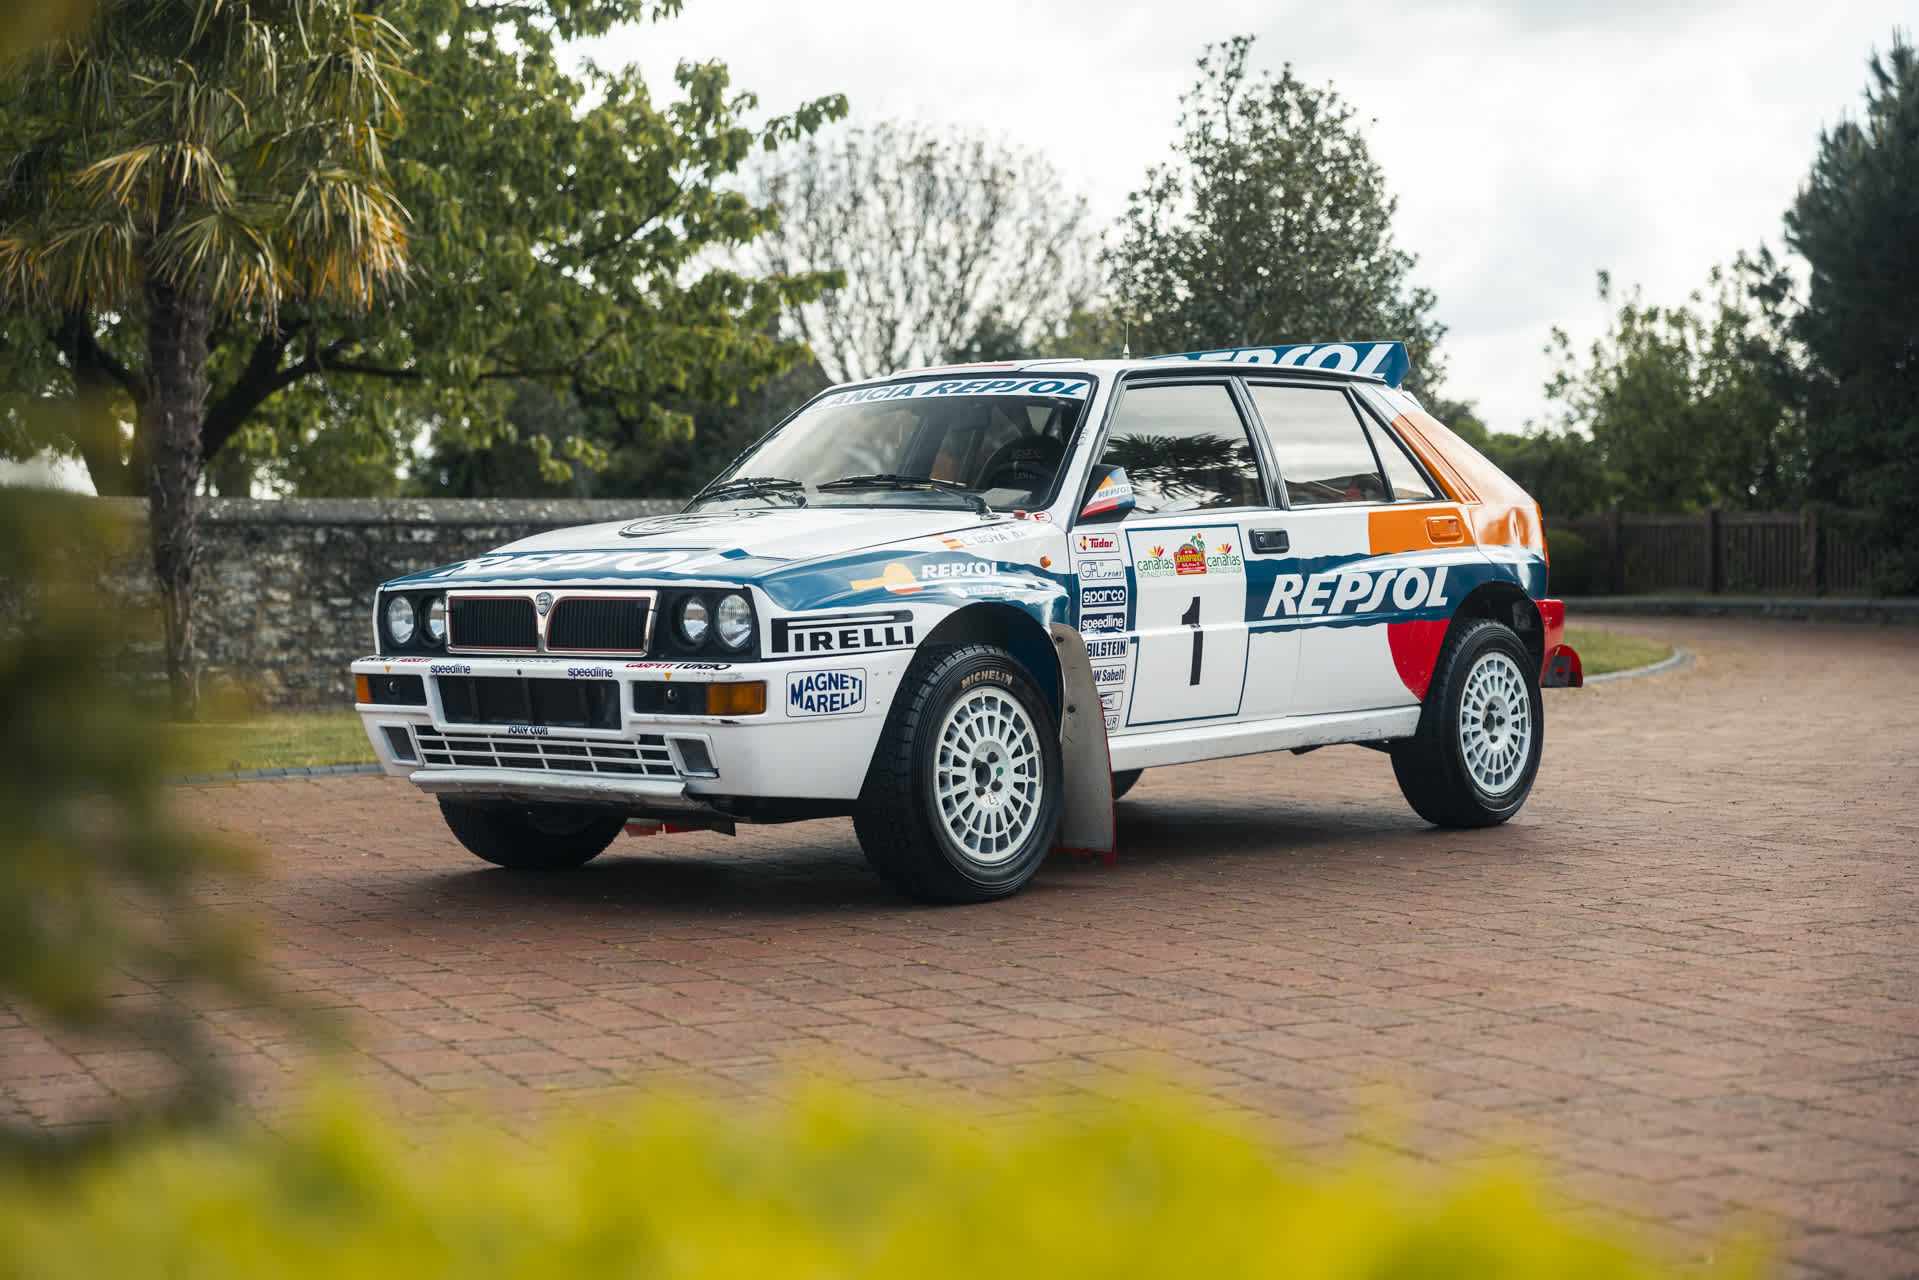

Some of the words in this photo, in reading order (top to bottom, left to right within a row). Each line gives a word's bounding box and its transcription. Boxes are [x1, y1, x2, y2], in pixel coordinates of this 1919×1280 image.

[922, 380, 1088, 397] REPSOL
[1088, 538, 1114, 549] Tudor
[922, 562, 1001, 578] REPSOL
[1083, 588, 1125, 604] sparco
[1262, 566, 1449, 617] REPSOL
[1082, 614, 1124, 630] speedline
[771, 610, 914, 653] PIRELLI
[1087, 640, 1126, 657] BILSTEIN
[1181, 596, 1204, 686] 1
[430, 664, 471, 677] speedline
[567, 666, 613, 680] speedline
[961, 669, 1013, 688] MICHELIN
[1102, 668, 1124, 682] Sabelt
[791, 672, 863, 699] MAGNETI
[791, 686, 863, 712] MARELLI
